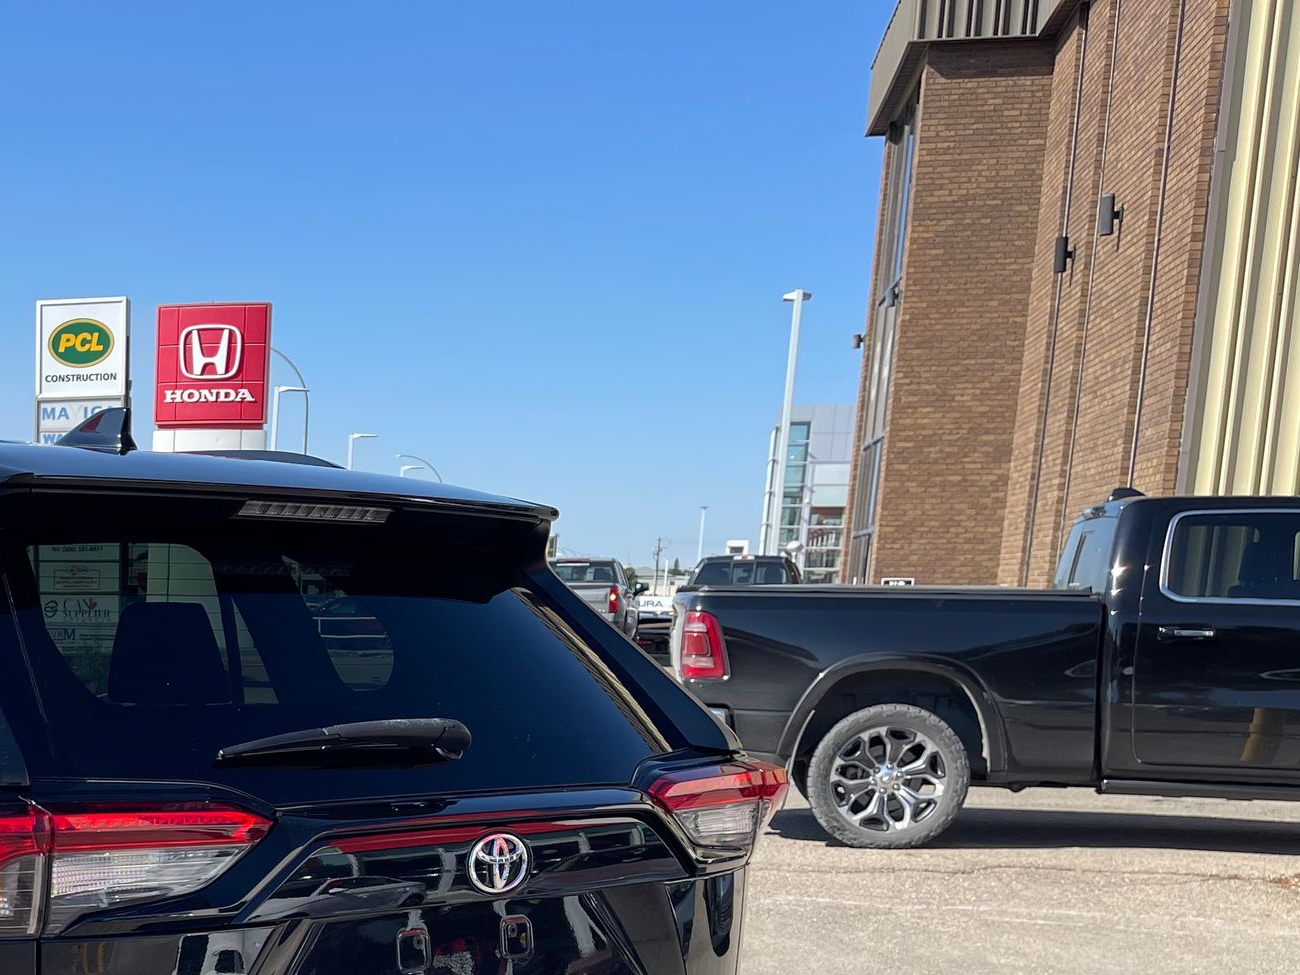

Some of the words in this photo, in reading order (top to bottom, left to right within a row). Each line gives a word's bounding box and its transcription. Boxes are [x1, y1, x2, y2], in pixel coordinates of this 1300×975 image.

[58, 332, 104, 353] PCL
[45, 372, 117, 383] CONSTRUCTION
[164, 388, 256, 403] HONDA
